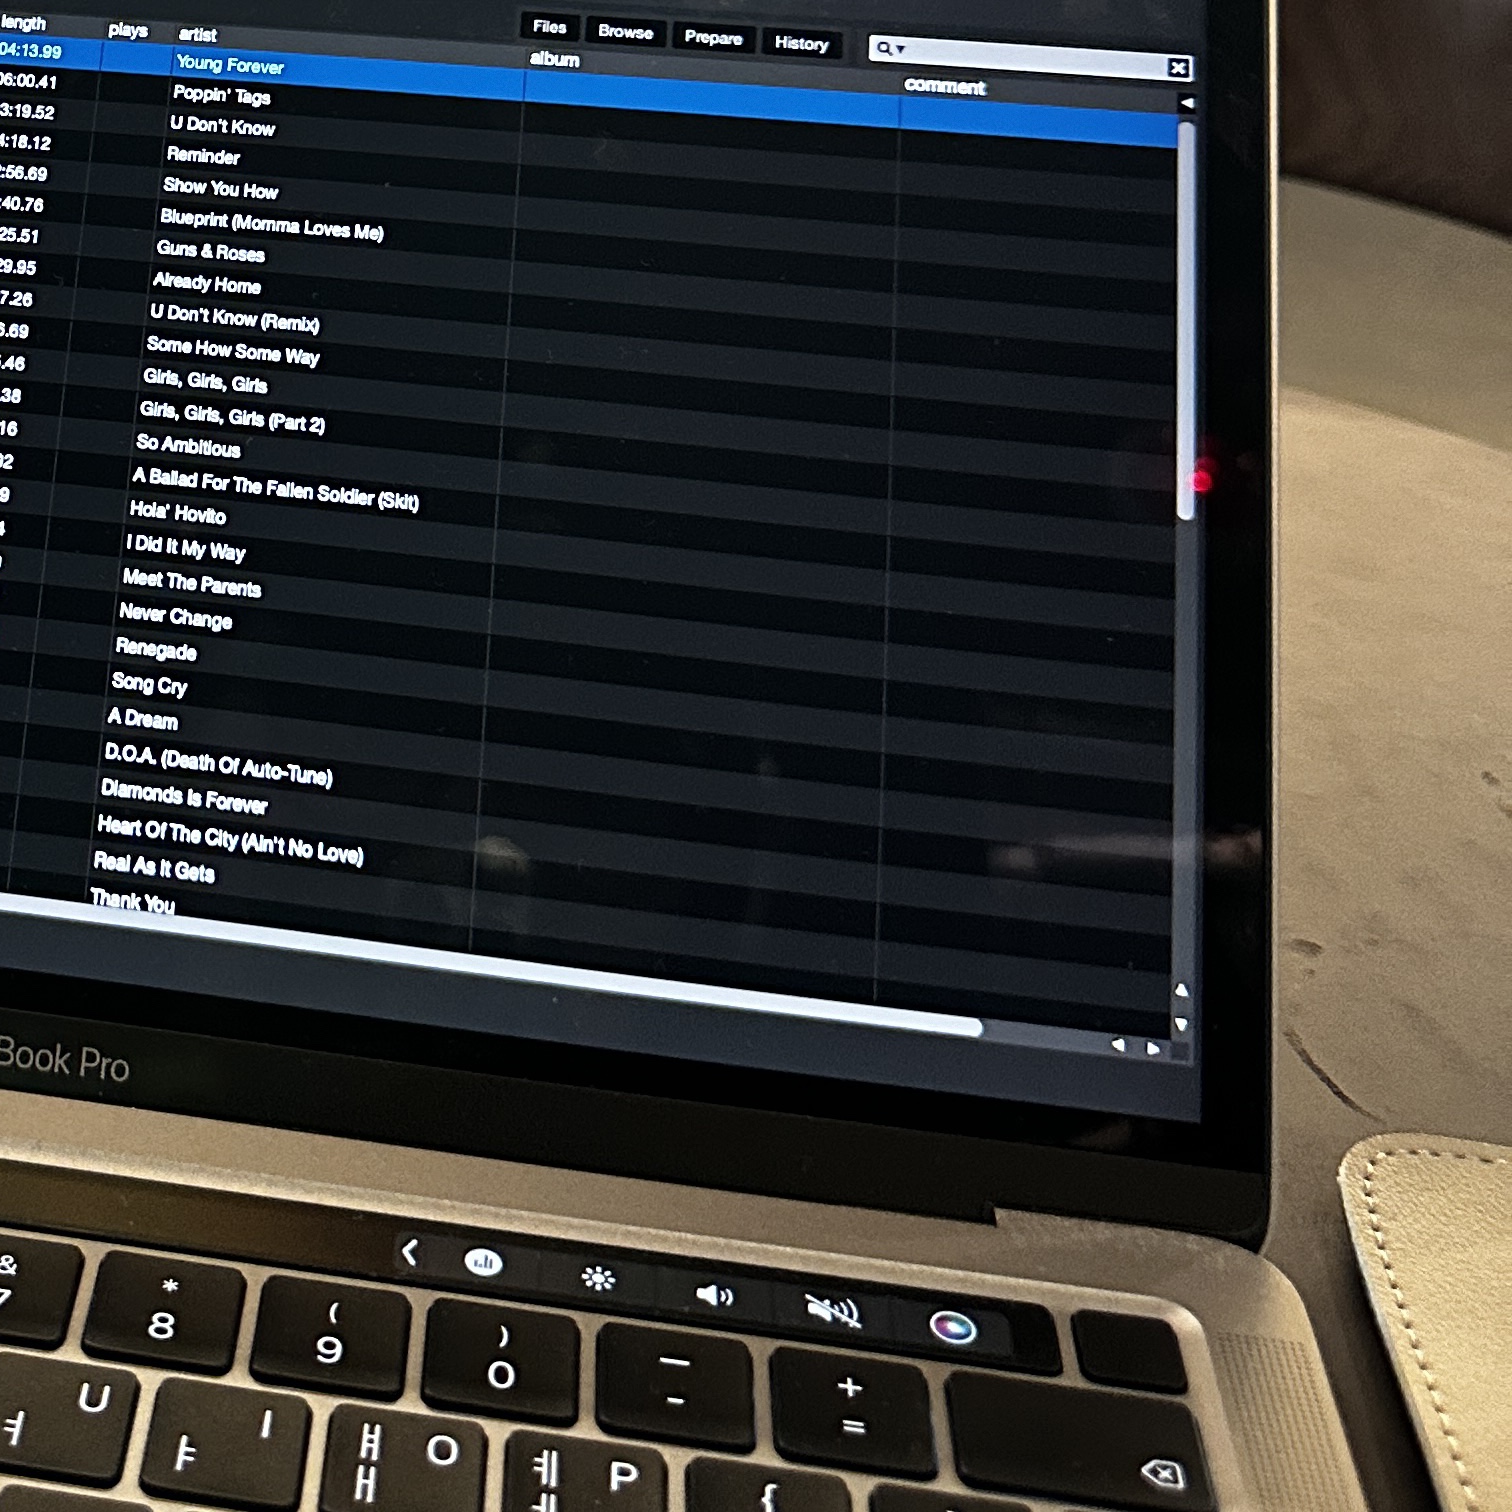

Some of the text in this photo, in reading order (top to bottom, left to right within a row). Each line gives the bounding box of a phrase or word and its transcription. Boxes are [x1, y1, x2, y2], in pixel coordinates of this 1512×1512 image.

[1, 14, 45, 37] length
[108, 21, 148, 44] plays
[178, 27, 217, 43] artist
[534, 20, 567, 34] Files
[599, 24, 654, 39] Browse
[685, 30, 743, 46] Prepare
[776, 36, 829, 53] History
[176, 53, 284, 75] Young Forever
[530, 51, 580, 67] album
[173, 83, 271, 108] Poppin' Tags
[903, 78, 986, 97] comment
[166, 145, 241, 165] Reminder
[152, 271, 262, 295] Already Home
[136, 433, 241, 459] So Ambitious
[115, 636, 197, 662] Renegade
[80, 1046, 130, 1083] Pro
[148, 1312, 174, 1338] 8
[317, 1336, 342, 1363] 9
[79, 1383, 110, 1412] U
[261, 1410, 271, 1438] I
[427, 1435, 458, 1465] O
[611, 1462, 638, 1491] P
